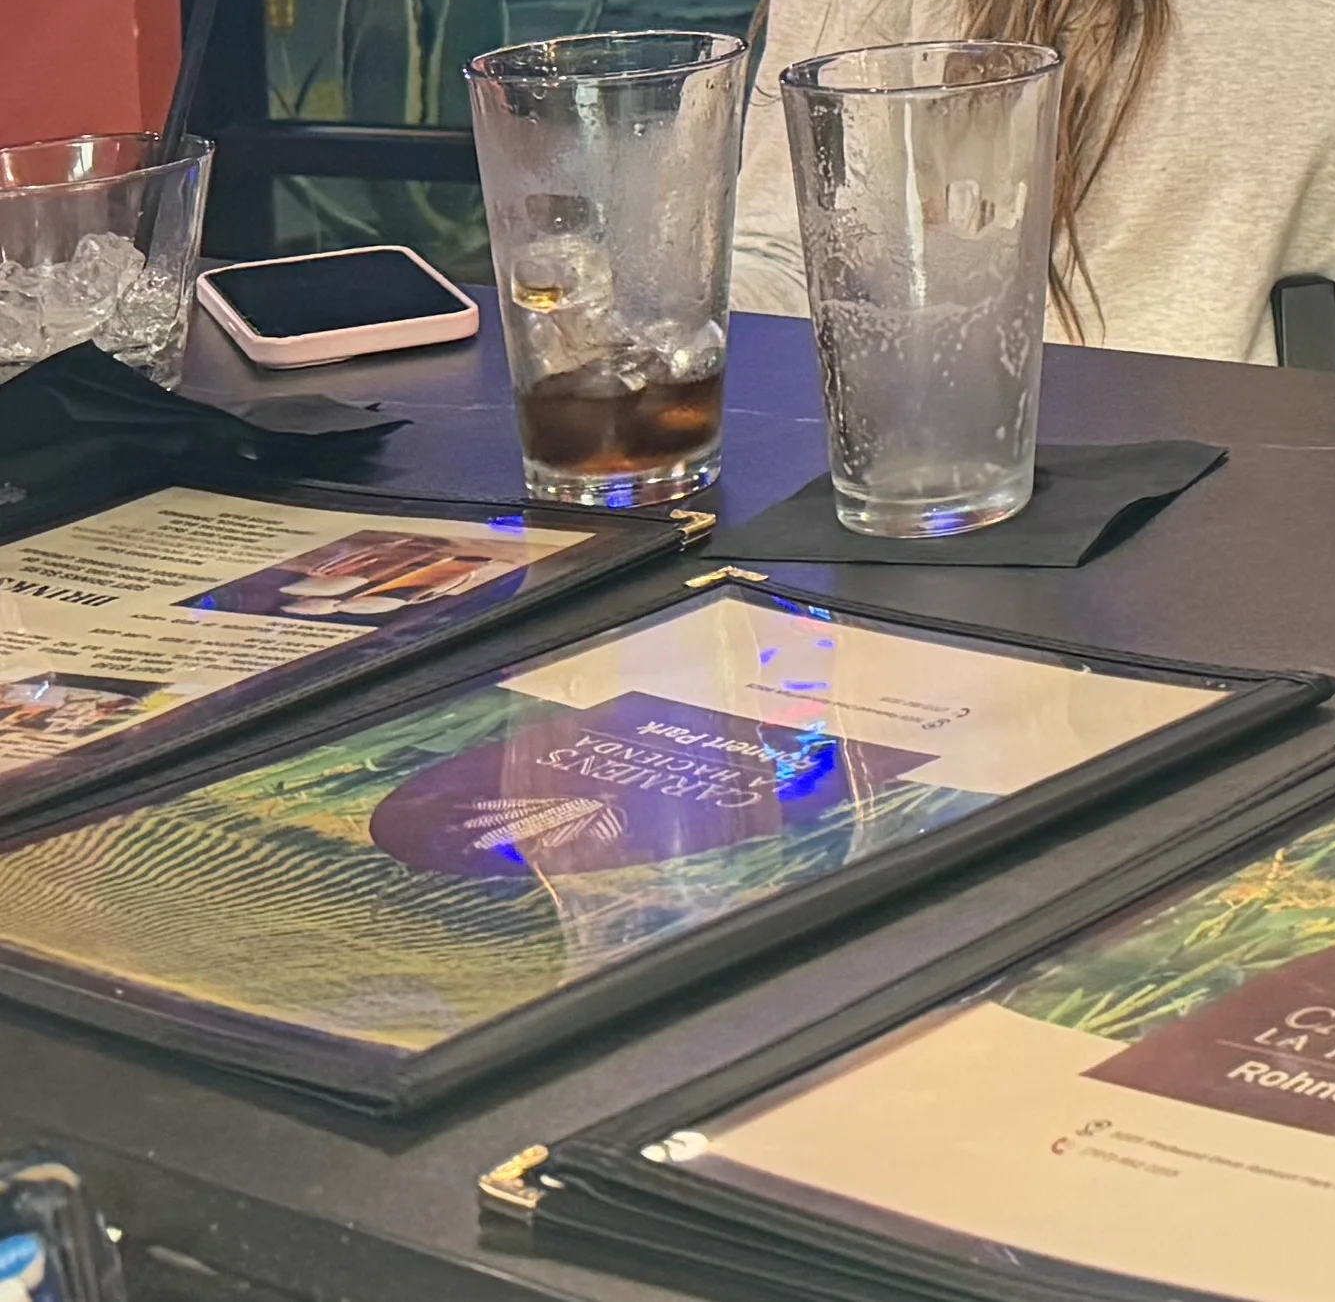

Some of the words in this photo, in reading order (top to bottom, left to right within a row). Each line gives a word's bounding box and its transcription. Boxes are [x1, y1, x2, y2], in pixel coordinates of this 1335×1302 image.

[636, 720, 709, 746] Park
[575, 735, 741, 781] HACIENDA
[536, 748, 763, 808] CARMEN'S
[1254, 1027, 1310, 1052] LA
